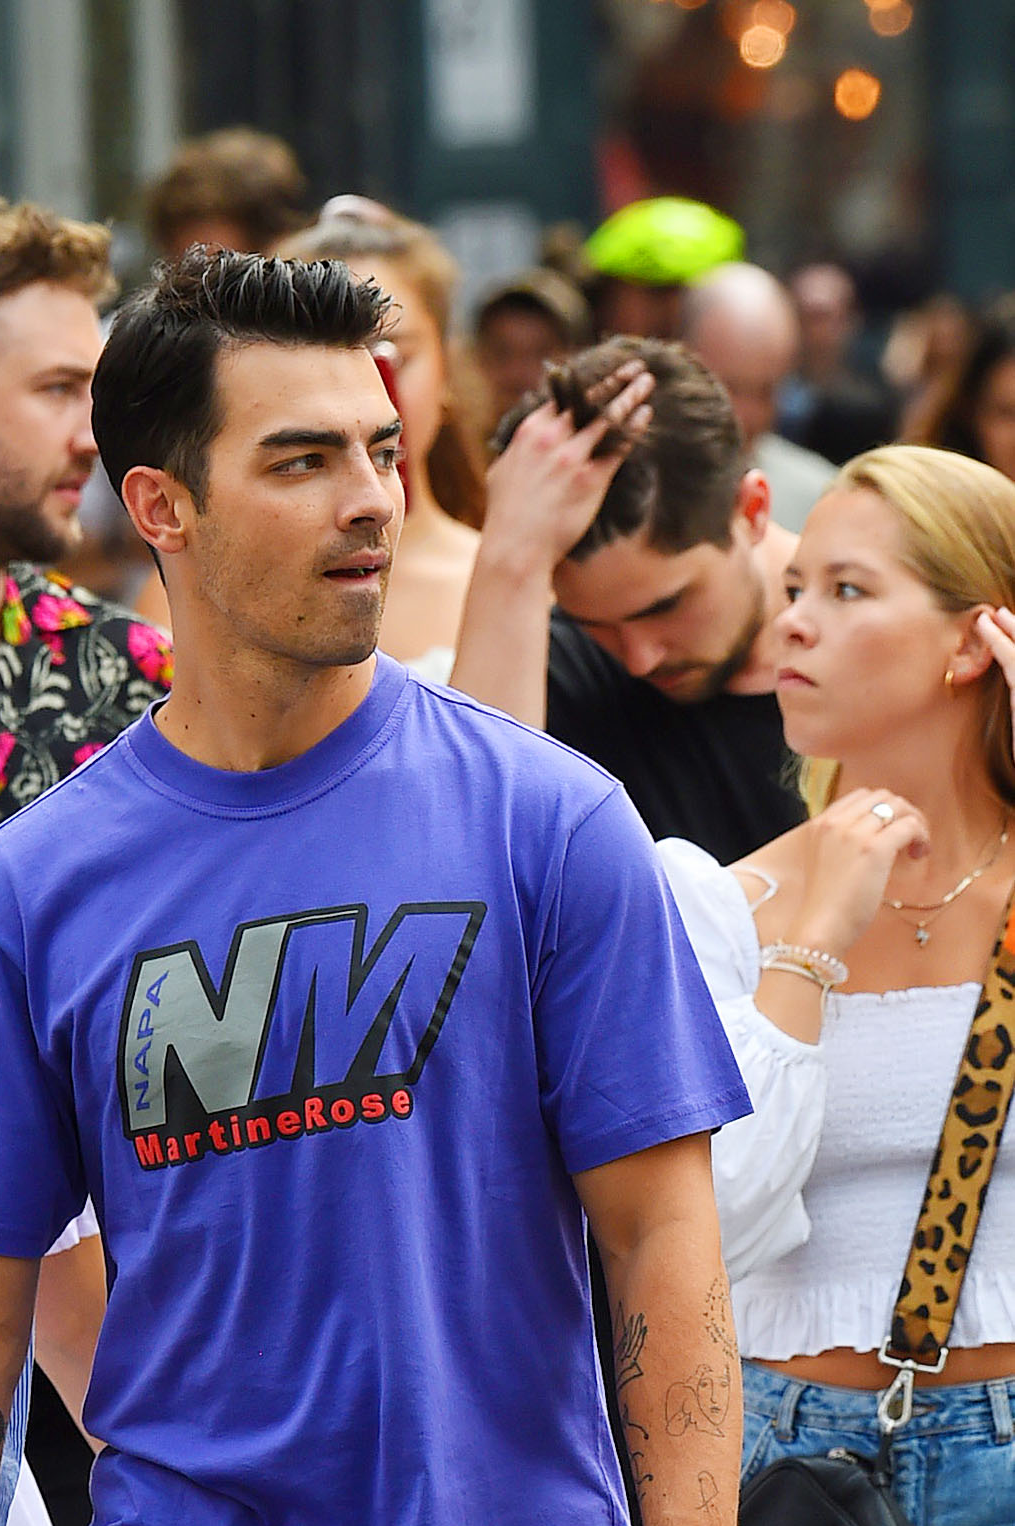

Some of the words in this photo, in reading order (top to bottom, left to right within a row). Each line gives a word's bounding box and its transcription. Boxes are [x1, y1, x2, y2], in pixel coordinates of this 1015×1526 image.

[119, 903, 486, 1131] NM
[134, 969, 169, 1110] NAPA
[134, 1089, 413, 1167] MartineRose
